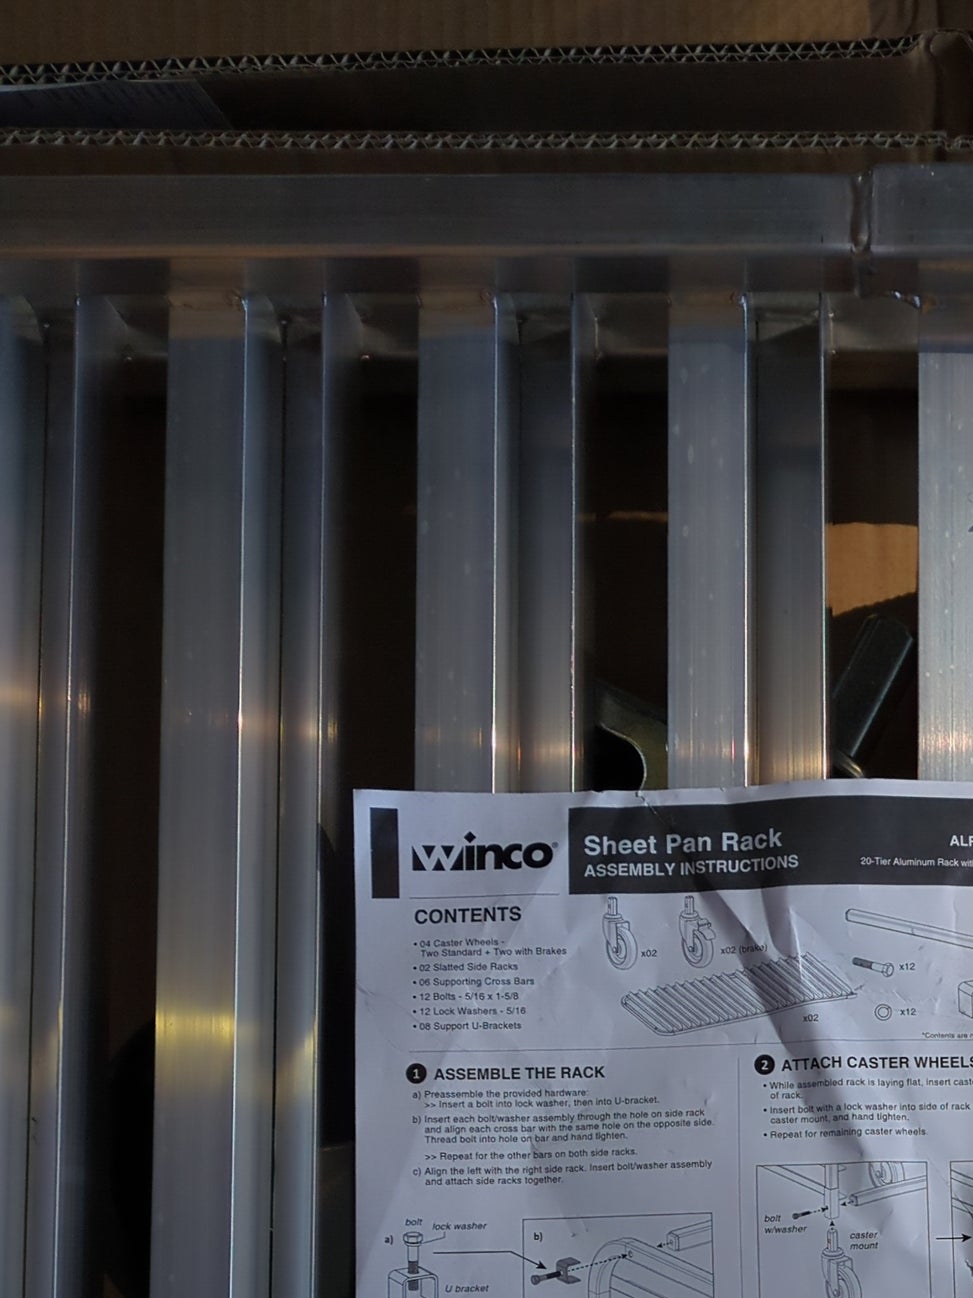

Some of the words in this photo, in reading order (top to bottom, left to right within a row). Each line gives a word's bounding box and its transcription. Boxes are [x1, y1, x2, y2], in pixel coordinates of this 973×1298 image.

[583, 835, 657, 855] Sheet
[666, 834, 712, 854] Pan
[721, 828, 782, 851] Rack
[583, 862, 675, 877] ASSEMBLY
[680, 855, 799, 874] INSTRUCTIONS
[860, 856, 891, 865] 20-Tier
[892, 857, 935, 866] Aluminum
[936, 857, 959, 867] Rack
[414, 906, 521, 924] CONTENTS
[419, 939, 431, 948] 04
[432, 938, 463, 947] Caster
[464, 937, 499, 946] Wheels
[420, 949, 439, 958] Two
[441, 948, 482, 957] Standard
[493, 947, 513, 956] Two
[514, 946, 533, 955] with
[535, 946, 567, 955] Brakes
[641, 948, 657, 958] x02
[720, 943, 738, 955] x02
[418, 963, 431, 972] 02
[432, 962, 464, 971] Slatted
[466, 962, 487, 971] Side
[489, 961, 518, 971] Racks
[898, 962, 916, 971] x12
[418, 977, 431, 987] 06
[432, 977, 482, 987] Supporting
[483, 976, 511, 986] Cross
[513, 976, 534, 985] Bars
[419, 992, 430, 1001] 12
[432, 991, 456, 1001] Bolts
[464, 991, 485, 1001] 5/16
[495, 991, 519, 1000] 1-5/8
[419, 1006, 431, 1016] 12
[432, 1007, 455, 1016] Lock
[456, 1006, 498, 1015] Washers
[505, 1006, 526, 1015] 5/16
[899, 1007, 919, 1016] x12
[802, 1013, 819, 1025] x02
[418, 1022, 431, 1031] 08
[433, 1021, 469, 1031] Support
[471, 1021, 522, 1030] U-Brackets
[781, 1056, 842, 1071] ATTACH
[846, 1056, 909, 1069] CASTER
[433, 1067, 521, 1080] ASSEMBLE
[524, 1066, 556, 1079] THE
[560, 1065, 605, 1078] RACK
[411, 1090, 421, 1100] a)
[423, 1090, 483, 1098] Preassemble
[485, 1089, 501, 1098] the
[502, 1088, 542, 1099] provided
[438, 1100, 465, 1108] Insert
[475, 1099, 493, 1108] bolt
[495, 1098, 512, 1108] into
[514, 1099, 533, 1108] lock
[535, 1099, 571, 1107] washer,
[573, 1098, 593, 1107] then
[595, 1097, 612, 1106] into
[614, 1095, 660, 1105] U-bracket.
[769, 1130, 802, 1139] Repeat
[804, 1129, 817, 1138] for
[819, 1127, 862, 1139] remaining
[864, 1127, 893, 1135] caster
[424, 1177, 443, 1186] and
[444, 1177, 473, 1185] attach
[475, 1176, 495, 1185] side
[497, 1176, 522, 1184] racks
[404, 1217, 423, 1226] bolt
[763, 1214, 781, 1223] bolt
[431, 1222, 451, 1232] lock
[453, 1222, 487, 1230] washer
[764, 1225, 807, 1234] w/washer
[384, 1234, 394, 1246] a)
[533, 1231, 543, 1243] b)
[849, 1230, 877, 1239] caster
[849, 1242, 878, 1250] mount
[444, 1284, 453, 1293] U
[454, 1284, 489, 1293] bracket
